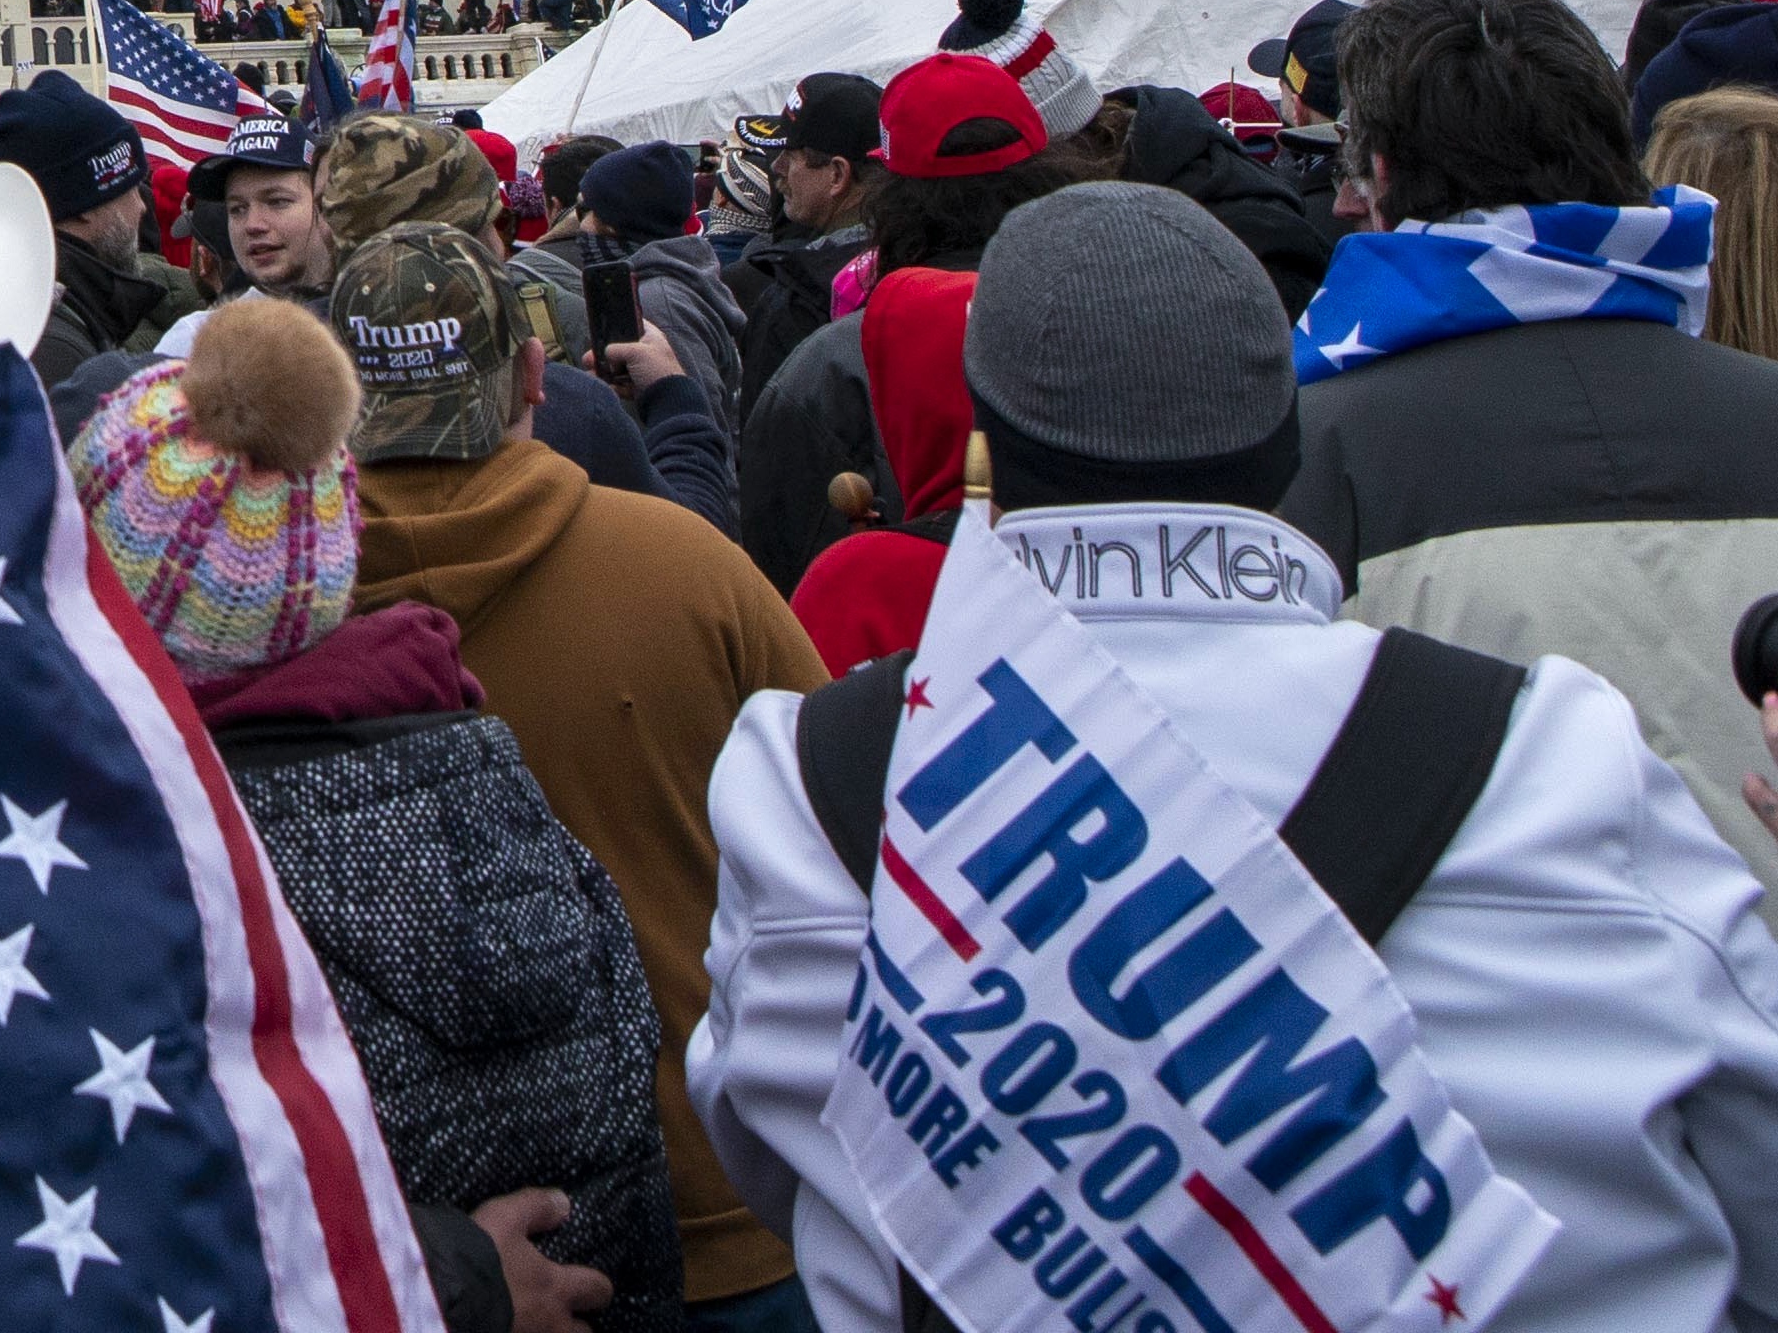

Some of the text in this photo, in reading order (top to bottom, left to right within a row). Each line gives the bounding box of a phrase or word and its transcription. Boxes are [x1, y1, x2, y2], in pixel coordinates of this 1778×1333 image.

[88, 140, 132, 173] Trump
[237, 136, 280, 151] AGAIN
[746, 132, 788, 146] PRESIDENT
[349, 315, 462, 352] Trump
[375, 369, 408, 382] MORE
[410, 365, 441, 381] BULL
[445, 361, 469, 375] SHIT
[388, 348, 434, 368] 2020
[1158, 524, 1308, 606] Klein
[897, 656, 1456, 1265] TRUMP
[848, 1003, 999, 1190] MORE
[922, 967, 1182, 1224] 2020
